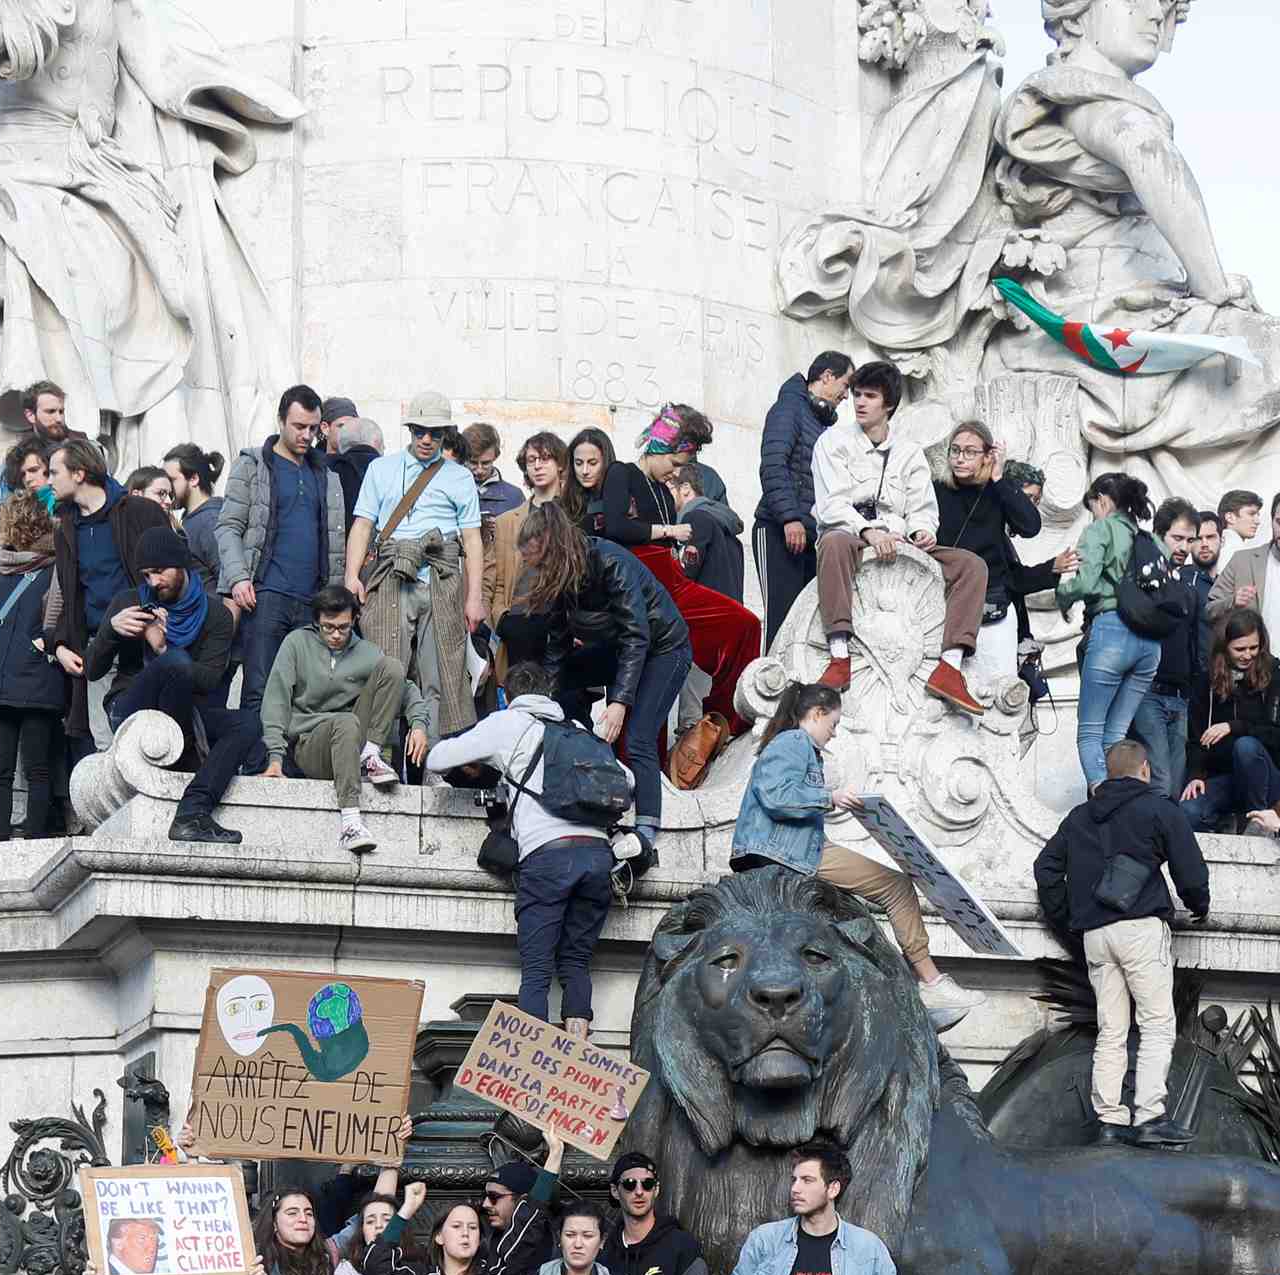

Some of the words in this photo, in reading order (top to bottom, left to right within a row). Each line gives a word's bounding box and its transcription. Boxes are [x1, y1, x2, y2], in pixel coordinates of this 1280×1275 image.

[555, 14, 600, 41] DE
[377, 49, 795, 172] RÉPUBLIQUE
[584, 241, 633, 284] LA
[577, 295, 639, 341] DE
[554, 356, 663, 406] 1883
[488, 1031, 521, 1058] PAS
[531, 1050, 562, 1075] DES
[563, 1066, 613, 1097] PIONS
[494, 1011, 545, 1042] NOUS
[551, 1035, 576, 1056] NE
[578, 1048, 645, 1086] SOMMES
[205, 1050, 312, 1100] ARRÊTEZ
[351, 1071, 388, 1104] DE
[477, 1052, 521, 1082] DANS
[520, 1073, 543, 1096] LA
[546, 1085, 610, 1121] PARTIE
[198, 1101, 276, 1144] NOUS
[281, 1107, 404, 1157] ENFUMER
[526, 1098, 550, 1119] DE
[96, 1180, 151, 1198] DON'T
[166, 1180, 227, 1196] WANNA
[100, 1201, 118, 1216] BE
[130, 1201, 167, 1216] LIKE
[174, 1197, 229, 1216] THAT?
[176, 1236, 200, 1251] ACT
[206, 1235, 237, 1252] FOR
[192, 1219, 232, 1233] THEN
[177, 1251, 243, 1273] CLIMATE
